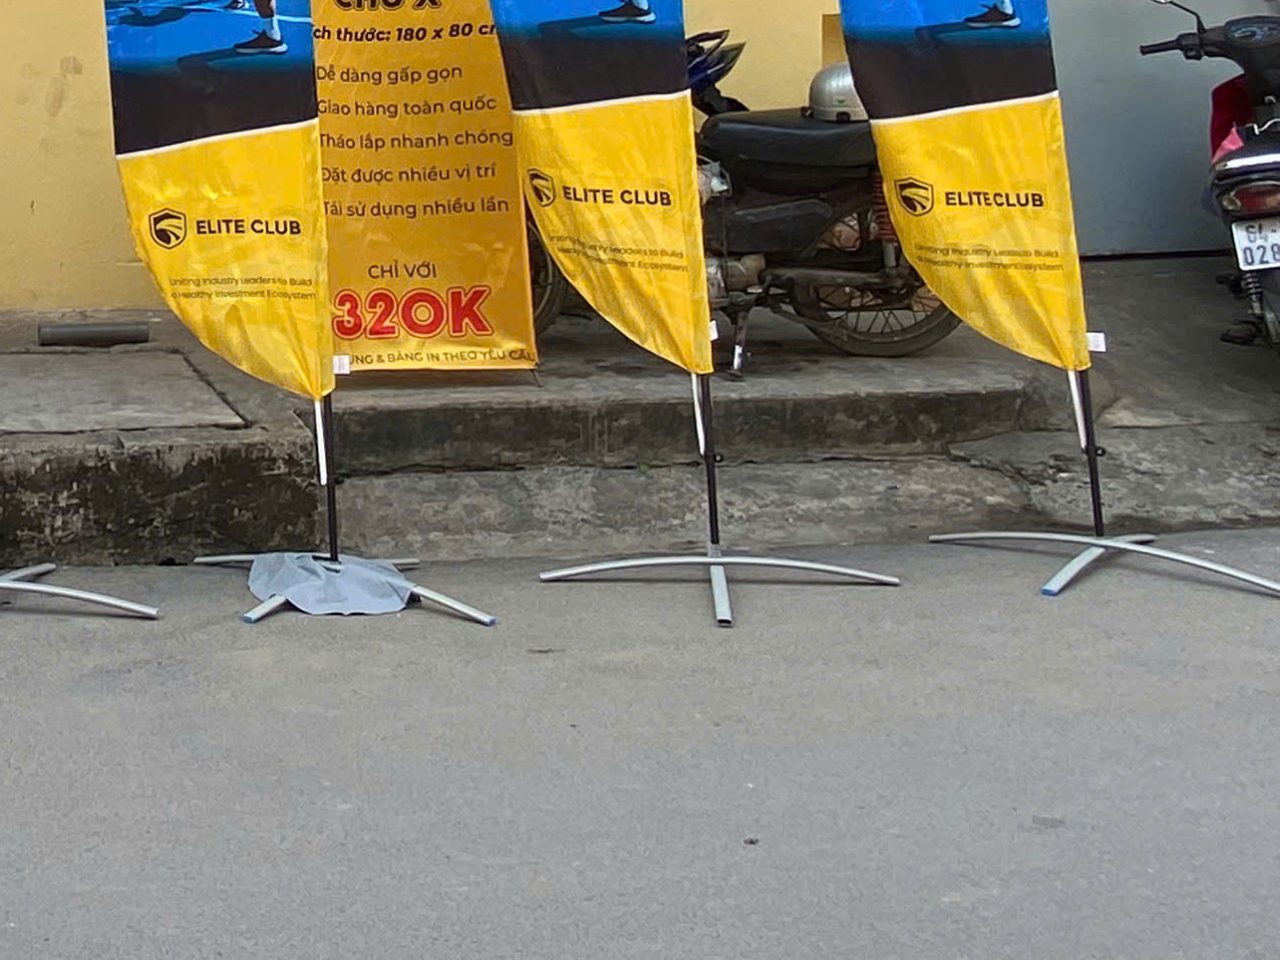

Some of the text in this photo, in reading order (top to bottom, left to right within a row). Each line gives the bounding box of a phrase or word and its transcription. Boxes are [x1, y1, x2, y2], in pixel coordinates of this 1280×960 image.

[313, 25, 332, 40] ch
[336, 26, 392, 42] thước:
[396, 28, 427, 42] 180
[432, 27, 444, 39] x
[448, 23, 474, 37] 80
[340, 67, 382, 85] dàng
[387, 66, 422, 85] gấp
[426, 66, 462, 84] gọn
[318, 94, 497, 118] Giao hàng toàn quốc
[320, 132, 356, 149] Tháo
[390, 133, 448, 148] nhanh
[454, 129, 514, 146] chóng
[350, 168, 394, 185] được
[398, 165, 450, 182] nhiều
[454, 164, 471, 182] vị
[475, 162, 496, 178] trí
[562, 186, 672, 206] ELITE CLUB
[945, 191, 1044, 208] ELITE CLUB
[346, 200, 366, 216] sử
[370, 202, 417, 220] dụng
[422, 198, 476, 216] nhiều
[196, 219, 302, 235] ELITE CLUB
[368, 260, 438, 278] CHỈ VỚI
[376, 354, 385, 363] &
[426, 352, 440, 362] IN
[442, 351, 477, 361] THEO
